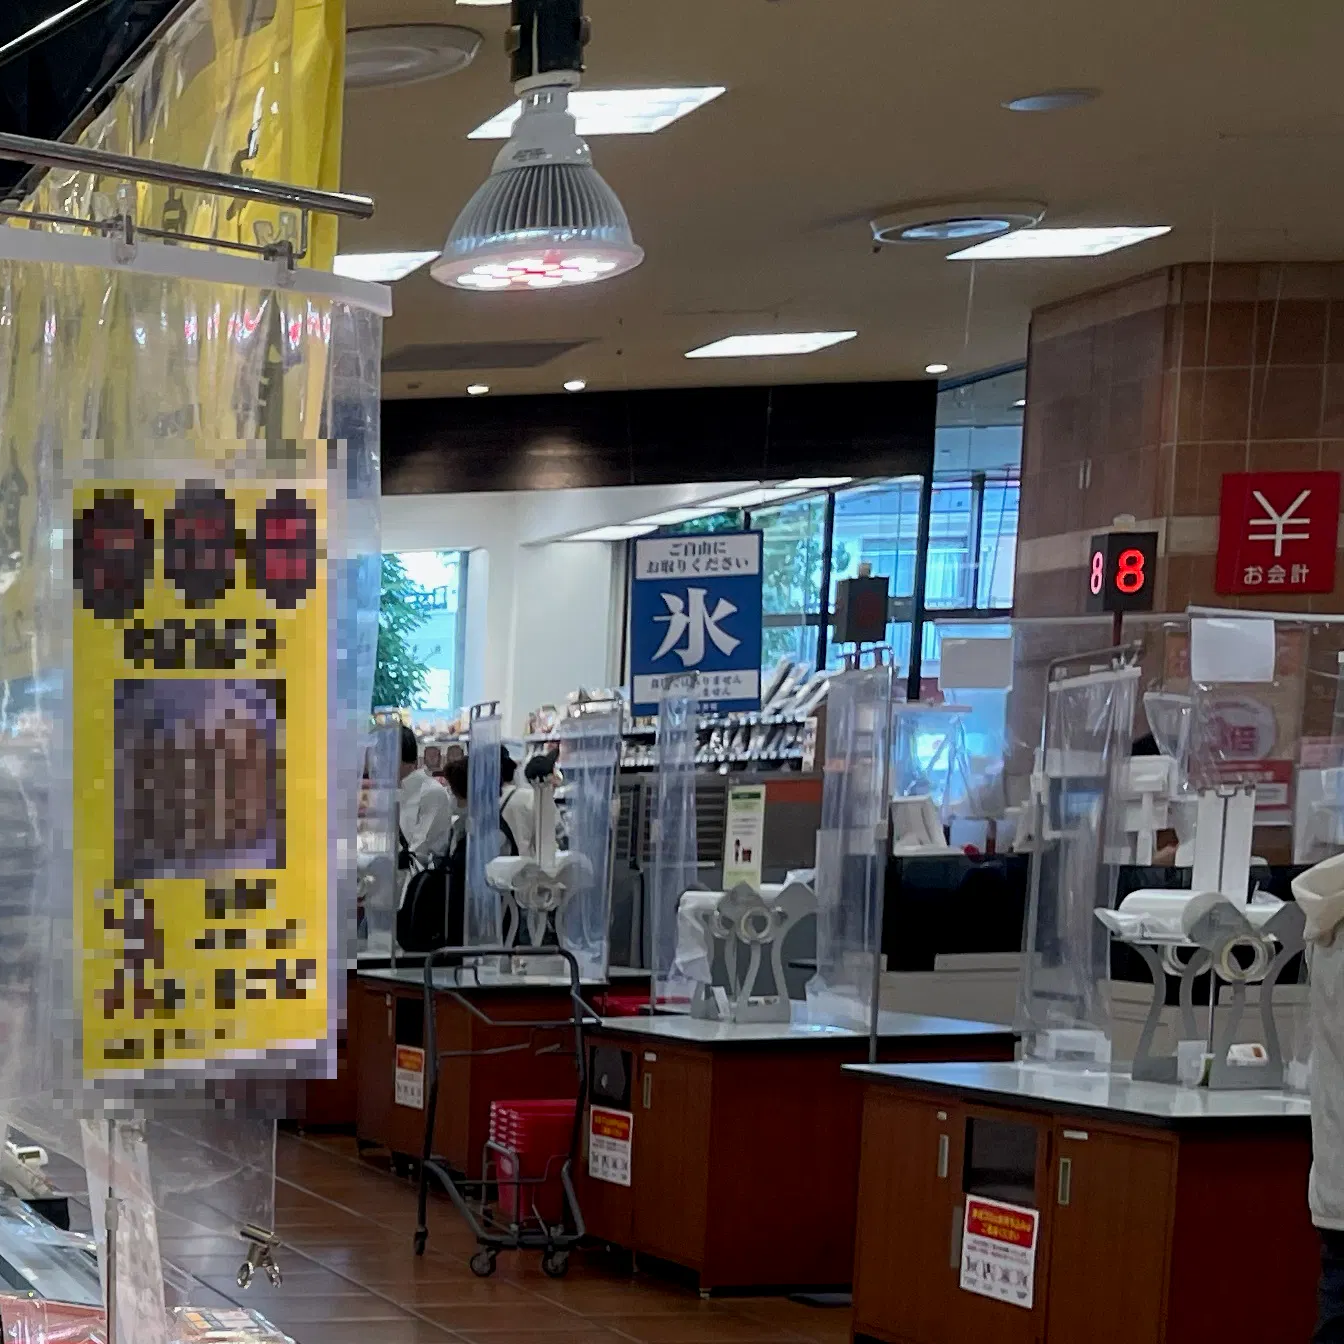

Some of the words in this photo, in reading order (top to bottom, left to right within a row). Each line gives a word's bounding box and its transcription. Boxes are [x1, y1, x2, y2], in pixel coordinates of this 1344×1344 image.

[669, 541, 728, 557] ご自由に
[646, 557, 749, 574] お取りください
[1115, 547, 1145, 594] 8
[1243, 563, 1310, 585] お会計
[651, 587, 742, 668] 氷
